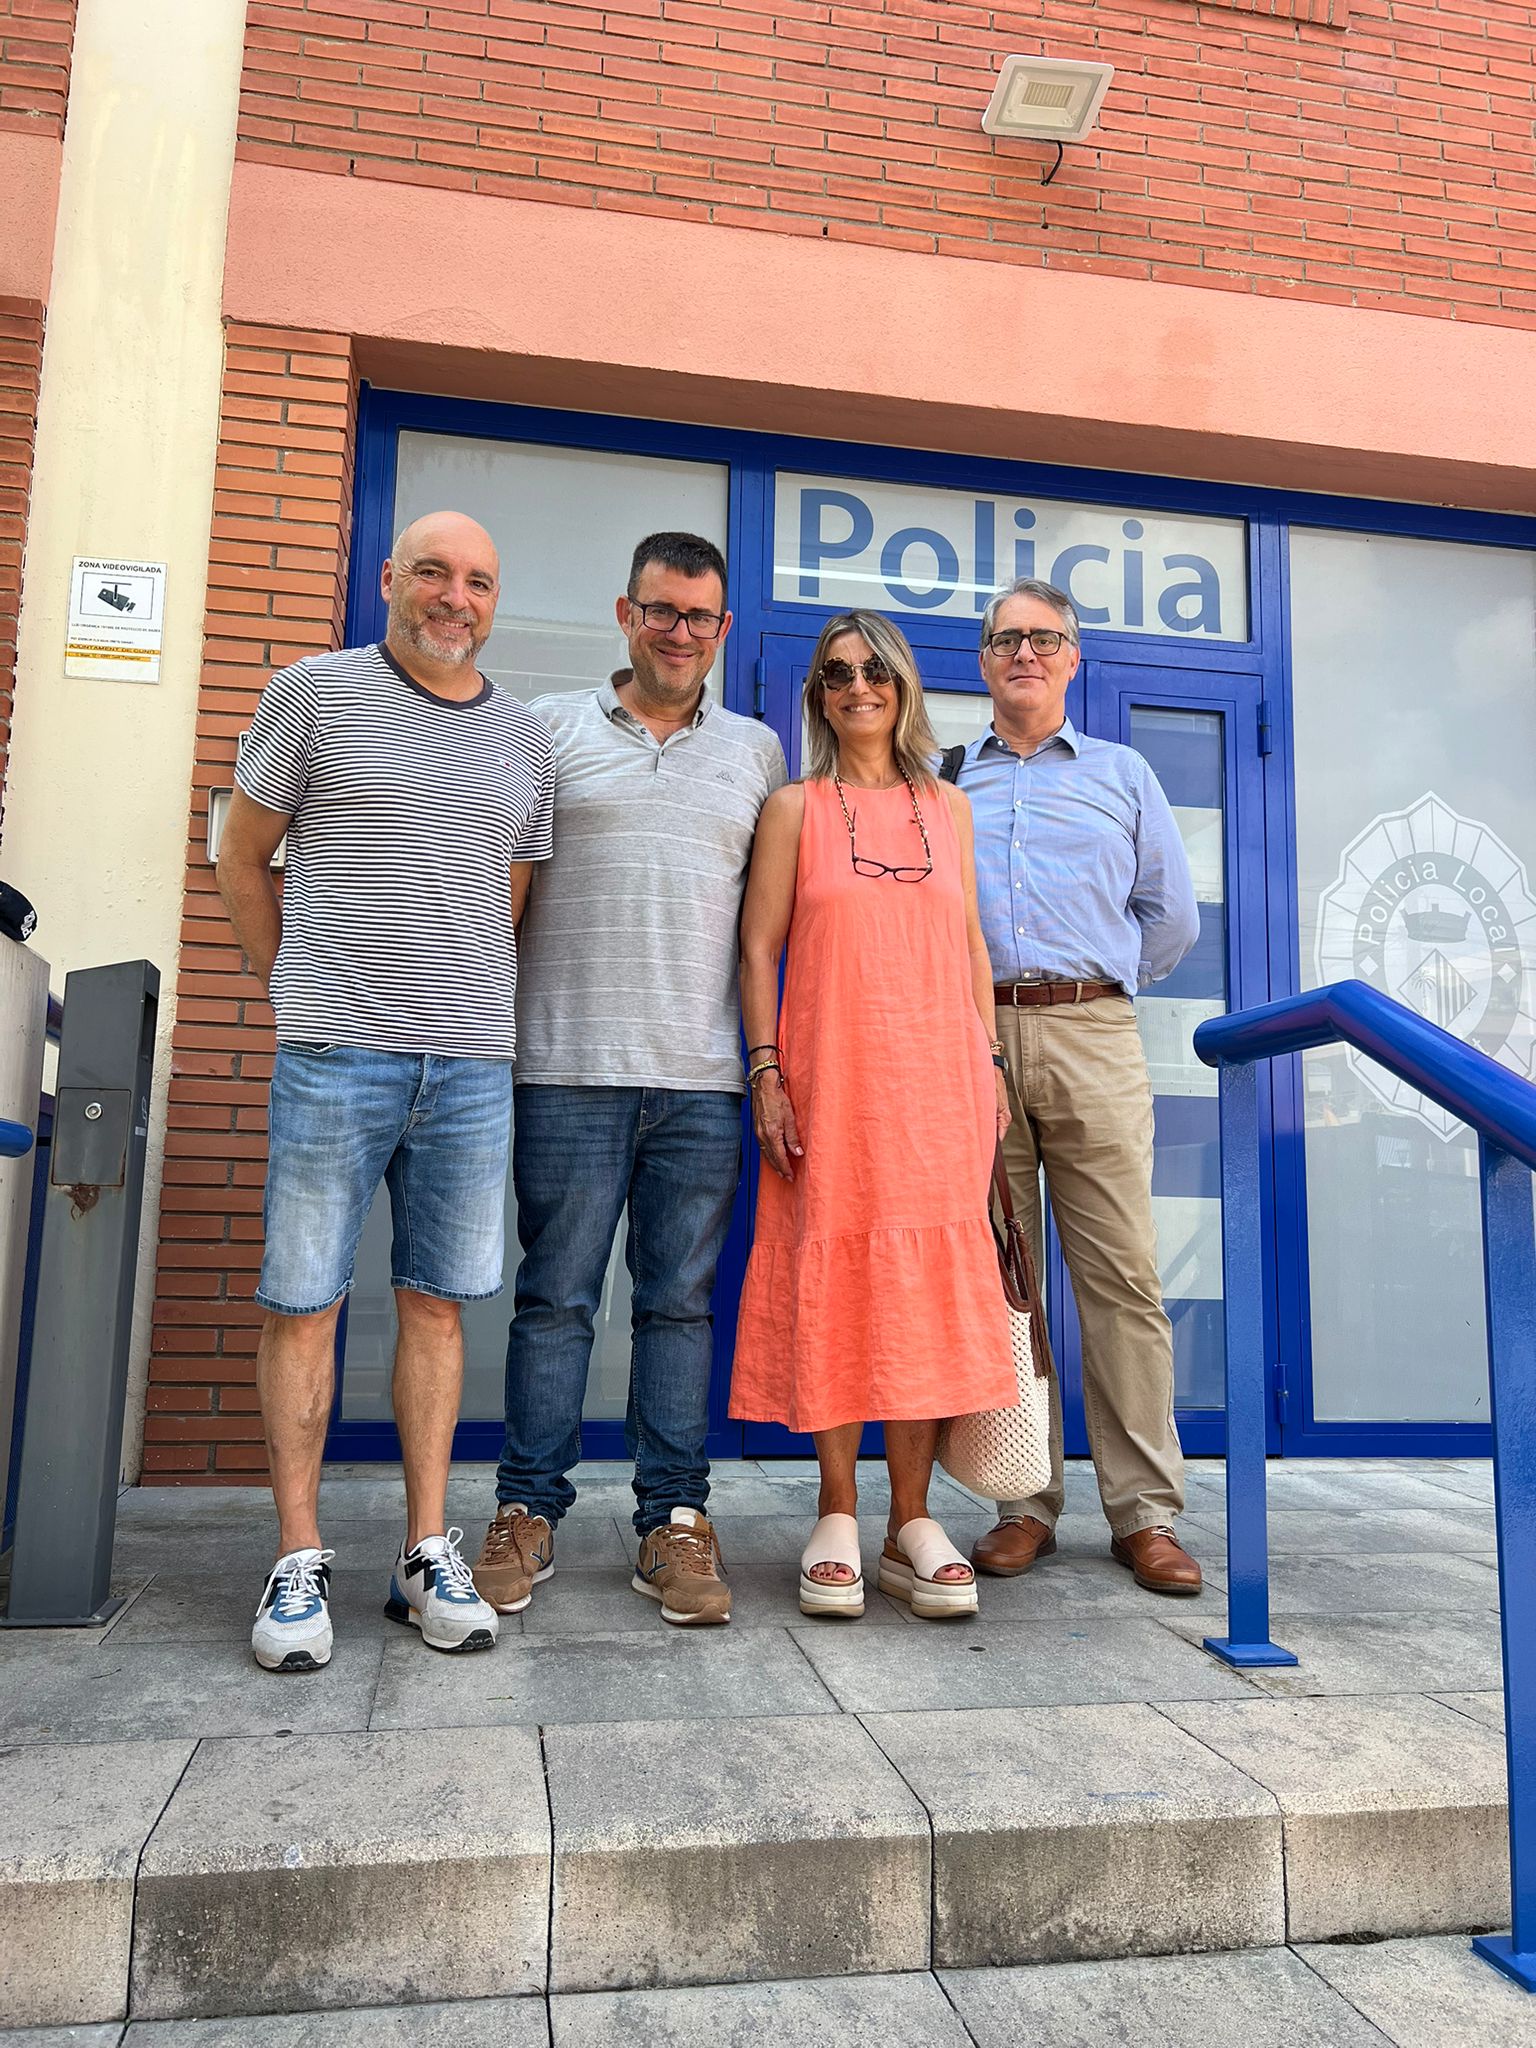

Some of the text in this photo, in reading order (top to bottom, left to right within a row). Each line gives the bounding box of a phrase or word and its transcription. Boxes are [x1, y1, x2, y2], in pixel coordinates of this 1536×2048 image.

[78, 561, 162, 574] ZONA VIDEOVIGILADA
[798, 488, 1222, 634] Policia
[1357, 859, 1516, 952] Policia Local
